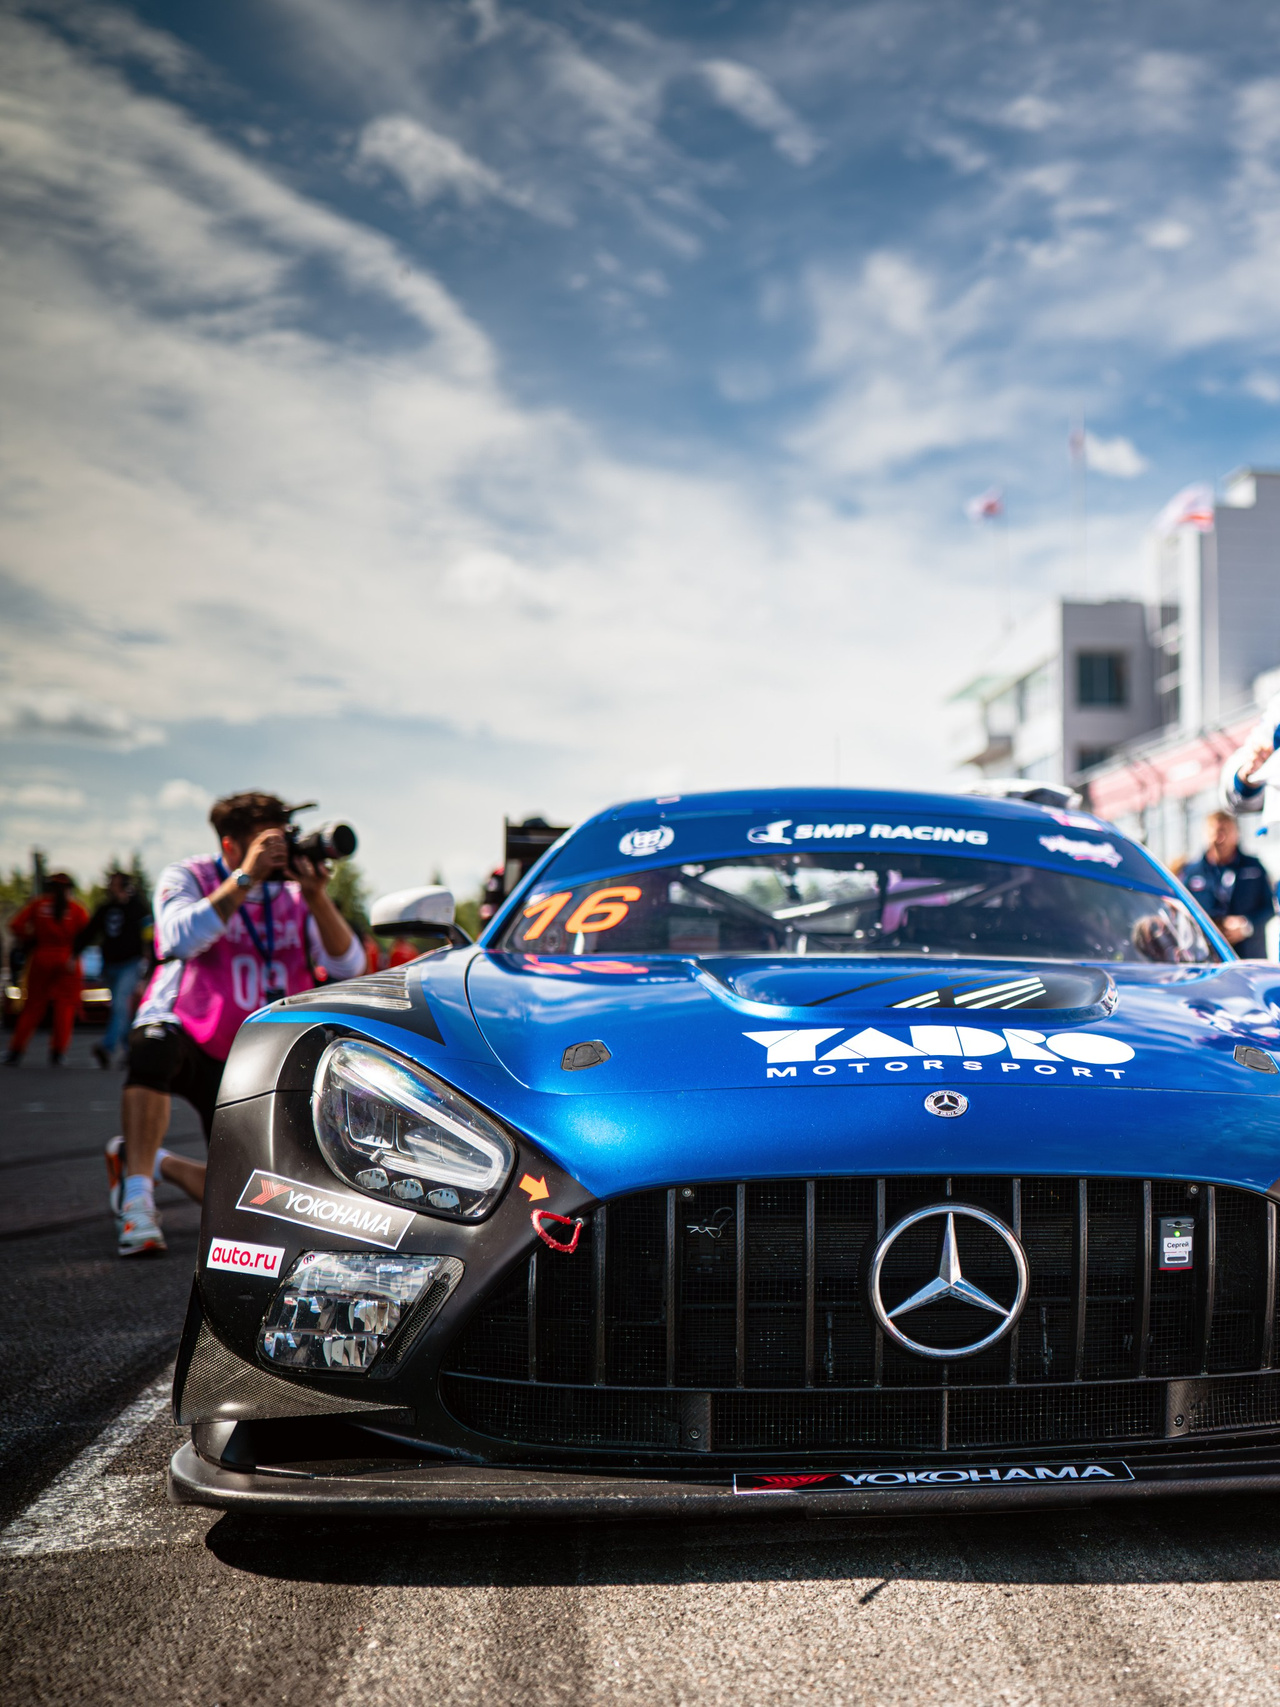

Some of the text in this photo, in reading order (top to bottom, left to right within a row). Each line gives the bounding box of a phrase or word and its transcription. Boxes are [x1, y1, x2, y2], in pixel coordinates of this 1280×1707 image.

[794, 823, 988, 846] SMP RACING
[522, 885, 642, 941] 16
[741, 1025, 1136, 1065] YADRO
[766, 1059, 1126, 1080] MOTORSPORT
[284, 1190, 393, 1237] YOKOHAMA
[1166, 1241, 1190, 1249] Сергей
[212, 1245, 278, 1271] auto.ru
[840, 1465, 1115, 1485] YOKOHAMA
